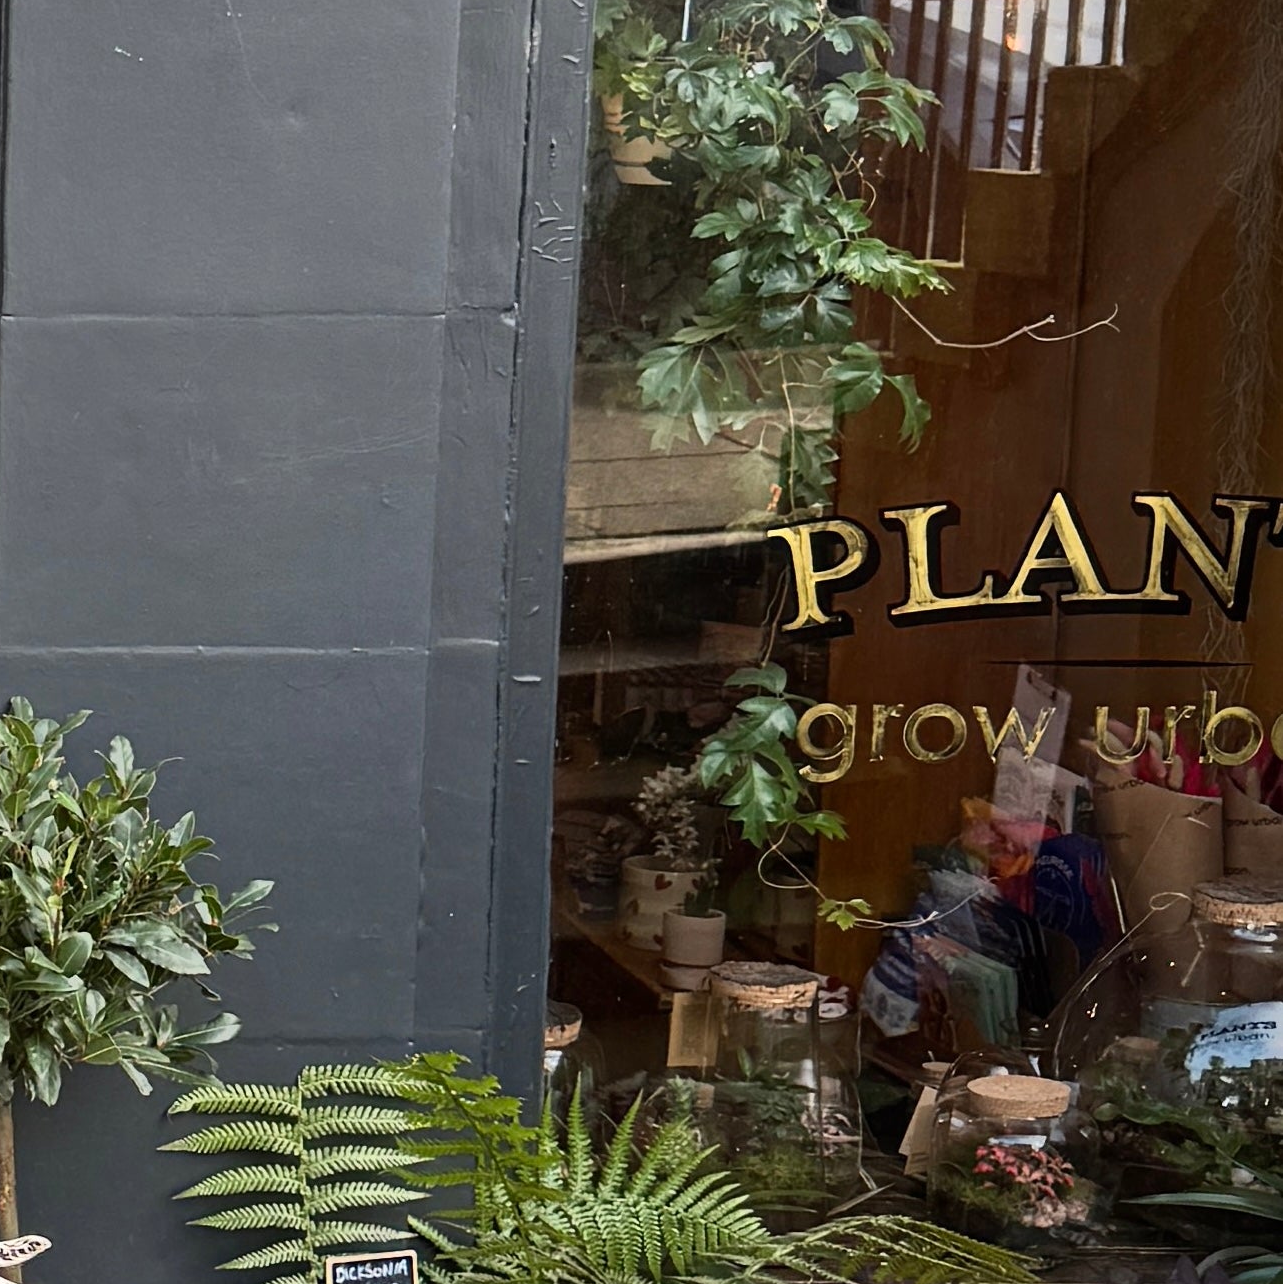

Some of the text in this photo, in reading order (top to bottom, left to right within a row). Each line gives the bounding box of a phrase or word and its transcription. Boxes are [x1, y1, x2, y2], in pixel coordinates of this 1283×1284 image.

[766, 489, 1283, 637] PLAN
[796, 690, 1283, 784] grow urb
[336, 1259, 408, 1283] DICKSONIA
